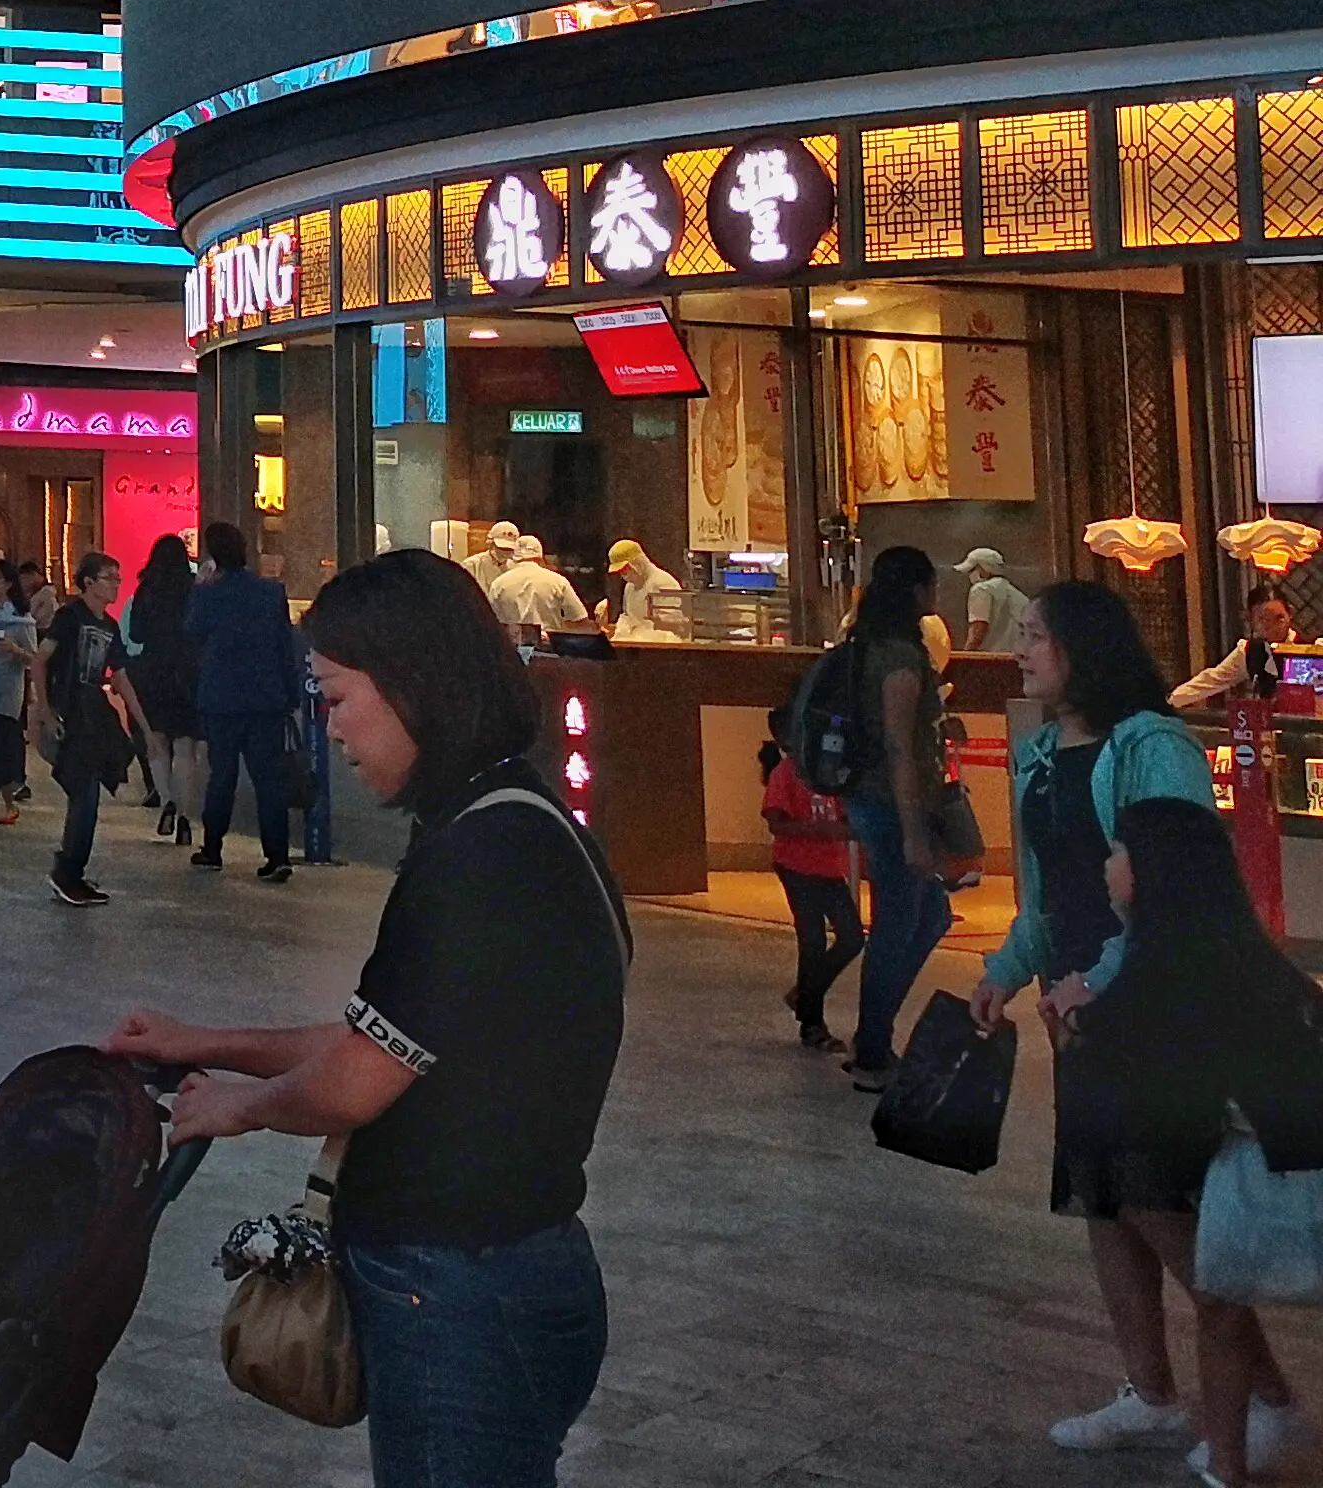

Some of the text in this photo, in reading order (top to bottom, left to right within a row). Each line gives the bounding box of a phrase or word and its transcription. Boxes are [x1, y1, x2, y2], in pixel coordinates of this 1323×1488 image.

[486, 148, 798, 282] 鼎泰豐
[213, 233, 295, 323] FUNG
[512, 413, 567, 431] KELUAR
